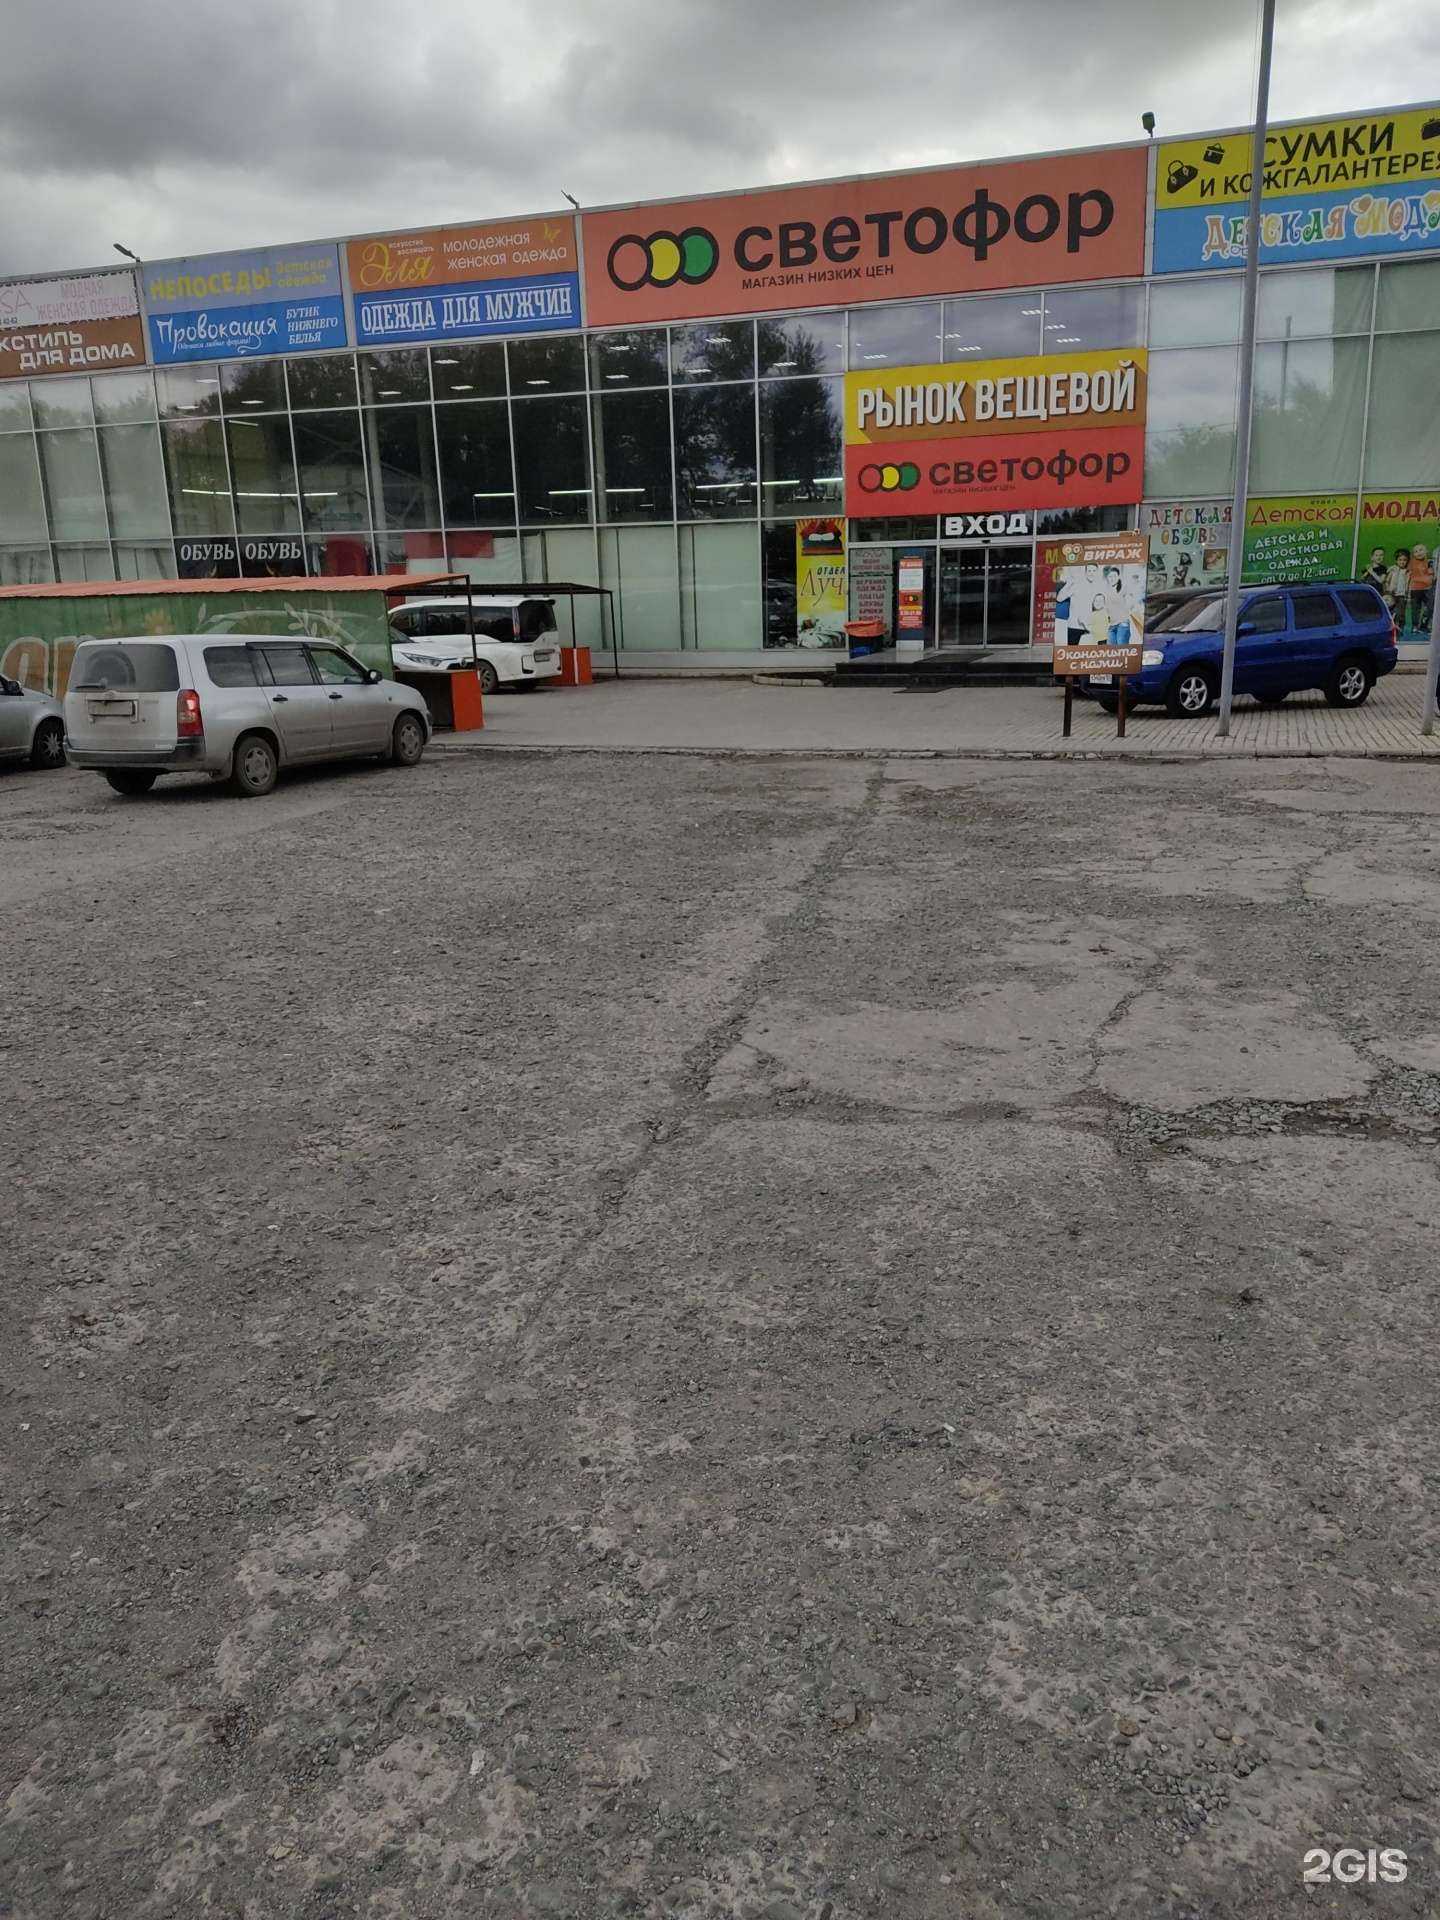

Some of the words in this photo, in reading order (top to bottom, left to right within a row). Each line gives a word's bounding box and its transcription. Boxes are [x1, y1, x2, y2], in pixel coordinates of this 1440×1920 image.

[1200, 177, 1216, 198] И
[1223, 150, 1440, 196] КОЖГАЛАНТЕРЕ
[1202, 204, 1347, 260] ДЕСКАЯ
[742, 274, 804, 290] МАГАЗИН
[808, 268, 862, 283] НИЗКИХ
[866, 264, 894, 279] ЦЕН
[286, 305, 320, 321] БУТИК
[361, 298, 436, 334] ОДЕЖДА
[442, 294, 483, 328] ДЛЯ
[486, 286, 572, 321] МУЖЧИН
[0, 331, 83, 352] КСТИЛЬ
[156, 313, 278, 354] Провокация
[288, 331, 322, 346] БЕЛЬЯ
[20, 349, 64, 370] ДЛЯ
[69, 342, 136, 366] ДОМА
[857, 379, 968, 430] РЫНОК
[974, 359, 1137, 421] ВЕЩЕВОЙ
[1149, 506, 1232, 528] ДЕТСКАЯ
[1251, 505, 1353, 526] Детская
[1363, 500, 1438, 522] МОДА
[945, 514, 1028, 536] ВХОД
[1161, 527, 1217, 545] ОБУВЬ
[1255, 530, 1315, 549] ДЕТСКАЯ
[1319, 528, 1328, 539] И
[180, 543, 235, 560] ОБУВЬ
[245, 542, 301, 560] ОБУВЬ
[1084, 549, 1142, 560] ВИРАЖ
[1248, 540, 1343, 562] ПОДРОСТКОВАЯ
[817, 566, 846, 575] ОТДЕЛ
[1269, 557, 1320, 570] ОДЕЖДА
[1302, 567, 1313, 578] 12
[1081, 657, 1128, 670] нами!
